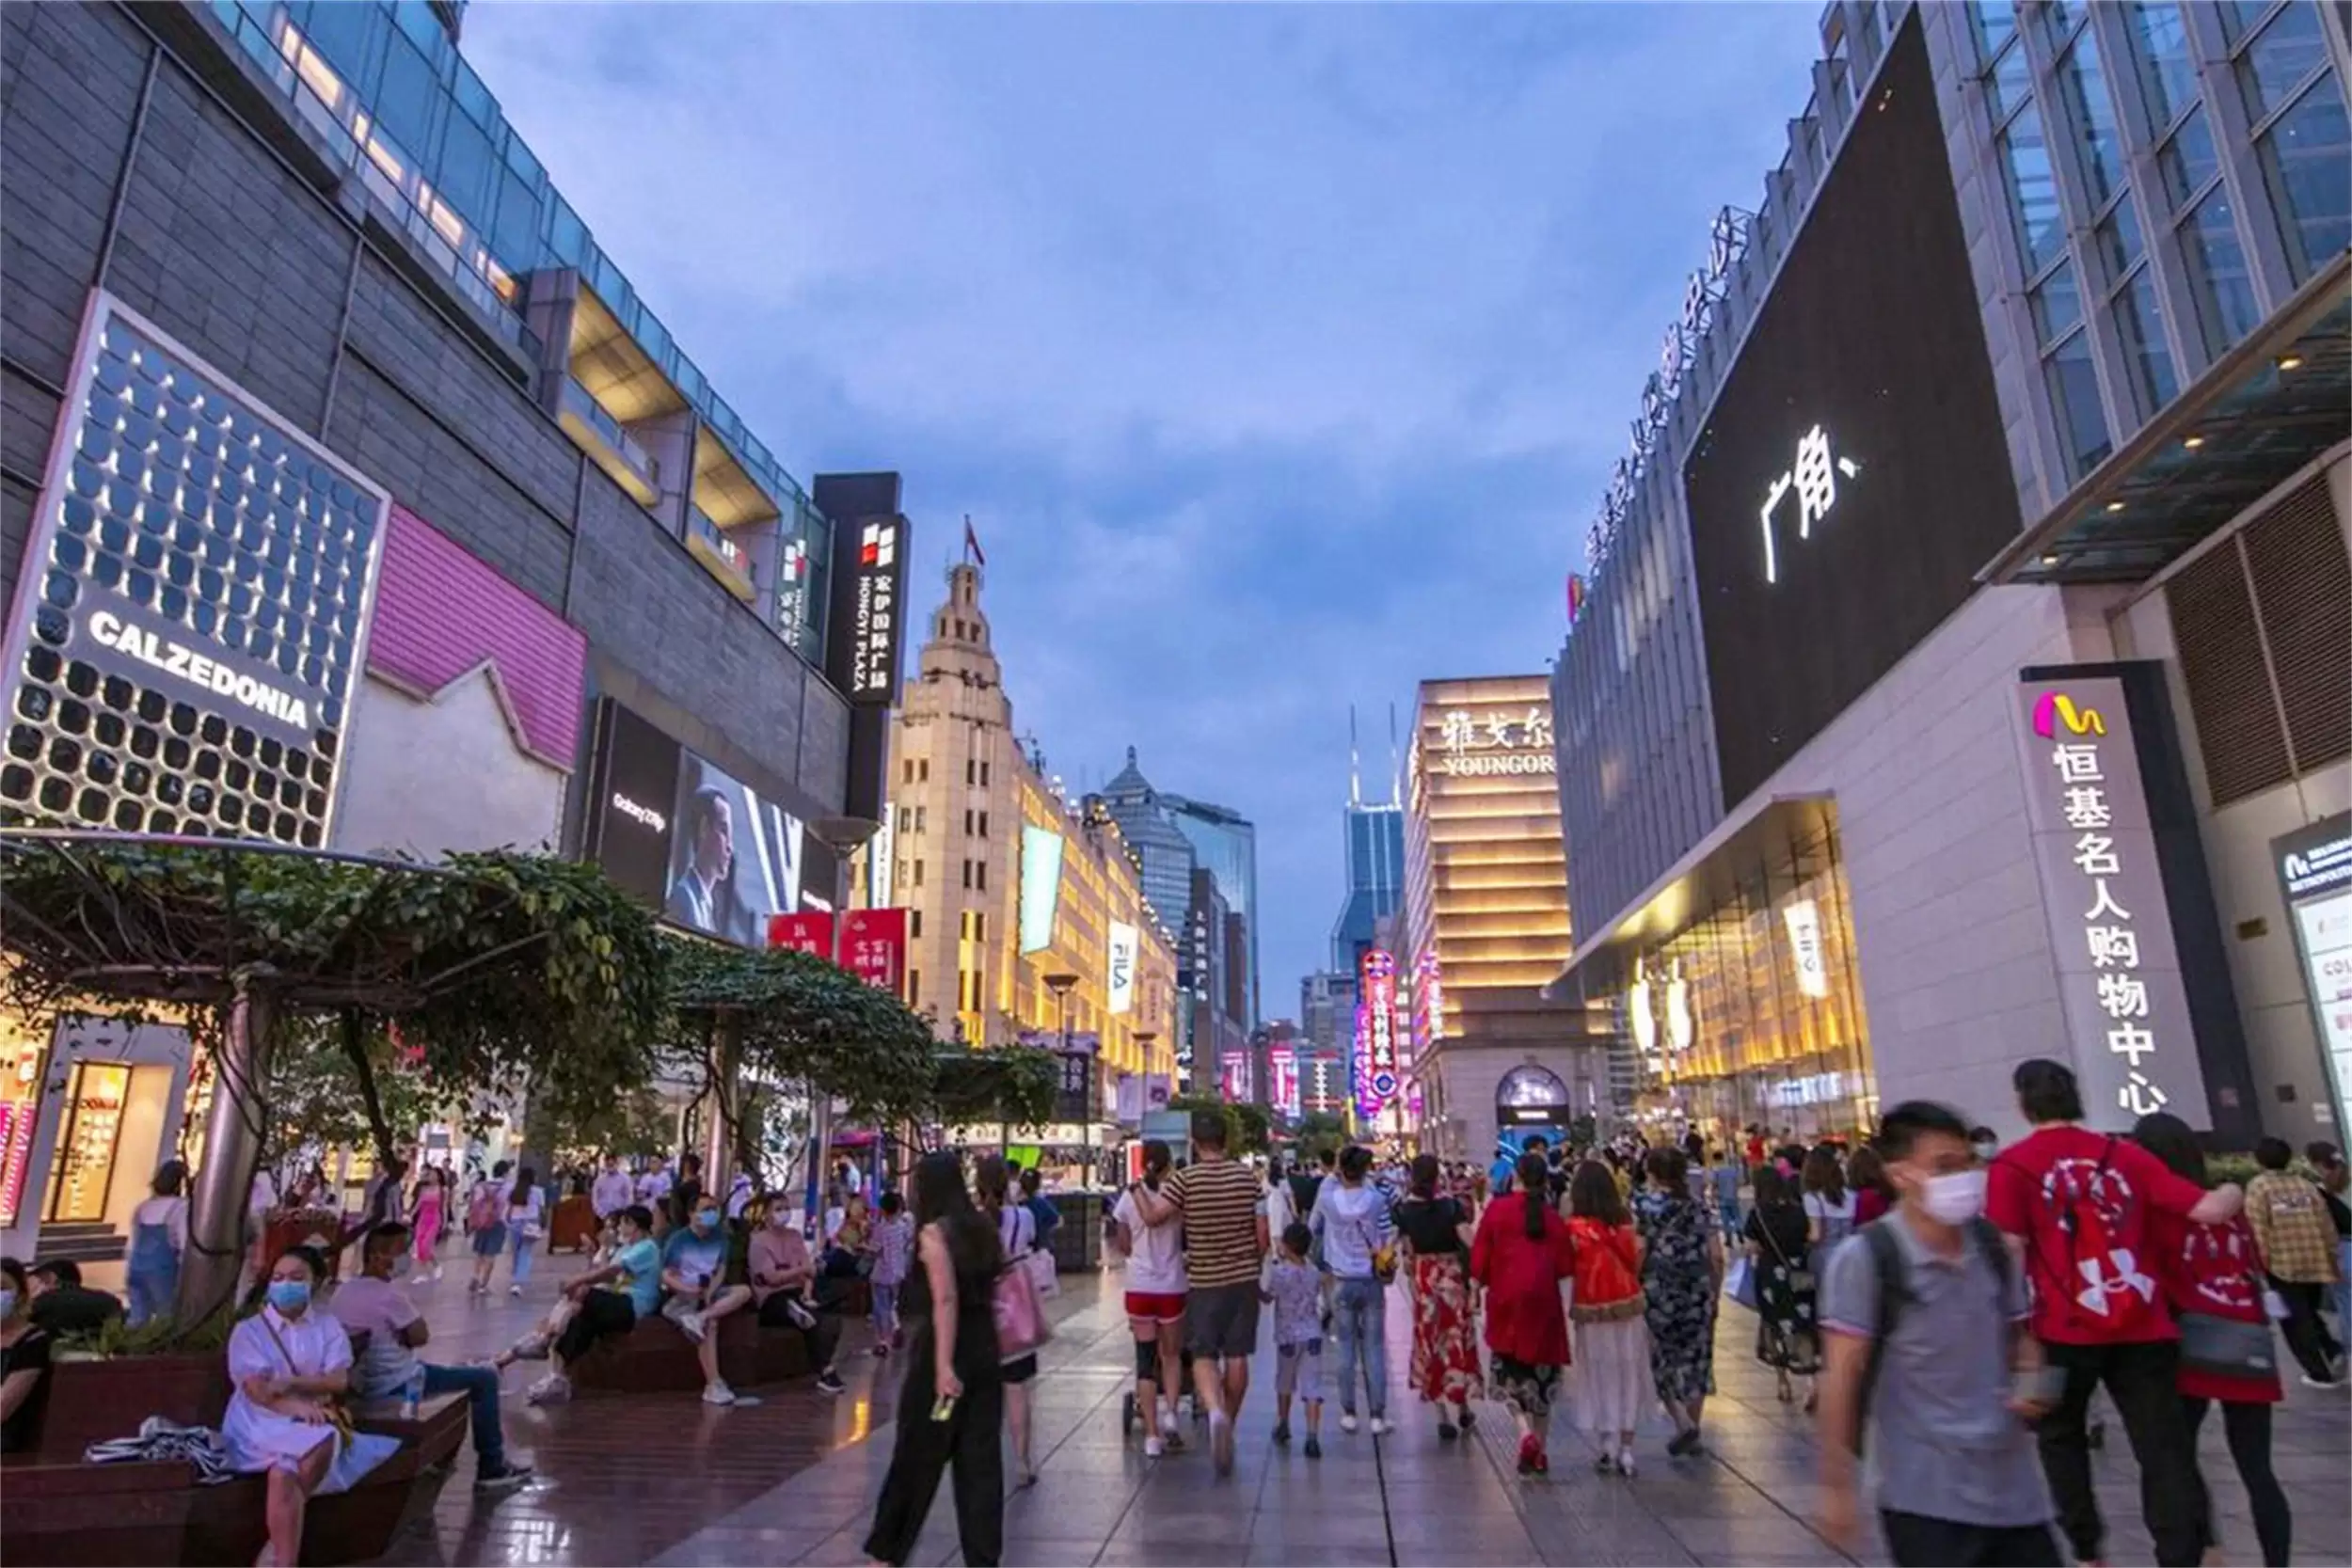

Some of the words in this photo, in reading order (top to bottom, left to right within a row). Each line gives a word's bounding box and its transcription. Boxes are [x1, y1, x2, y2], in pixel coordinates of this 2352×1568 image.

[856, 576, 872, 636] HONGYI
[89, 611, 308, 730] CALZEDONIA
[852, 641, 868, 693] PLAZA
[1442, 754, 1557, 776] YOUNGOR
[2053, 743, 2168, 1117] 恒基名人购物中心
[1113, 943, 1129, 990] FILA
